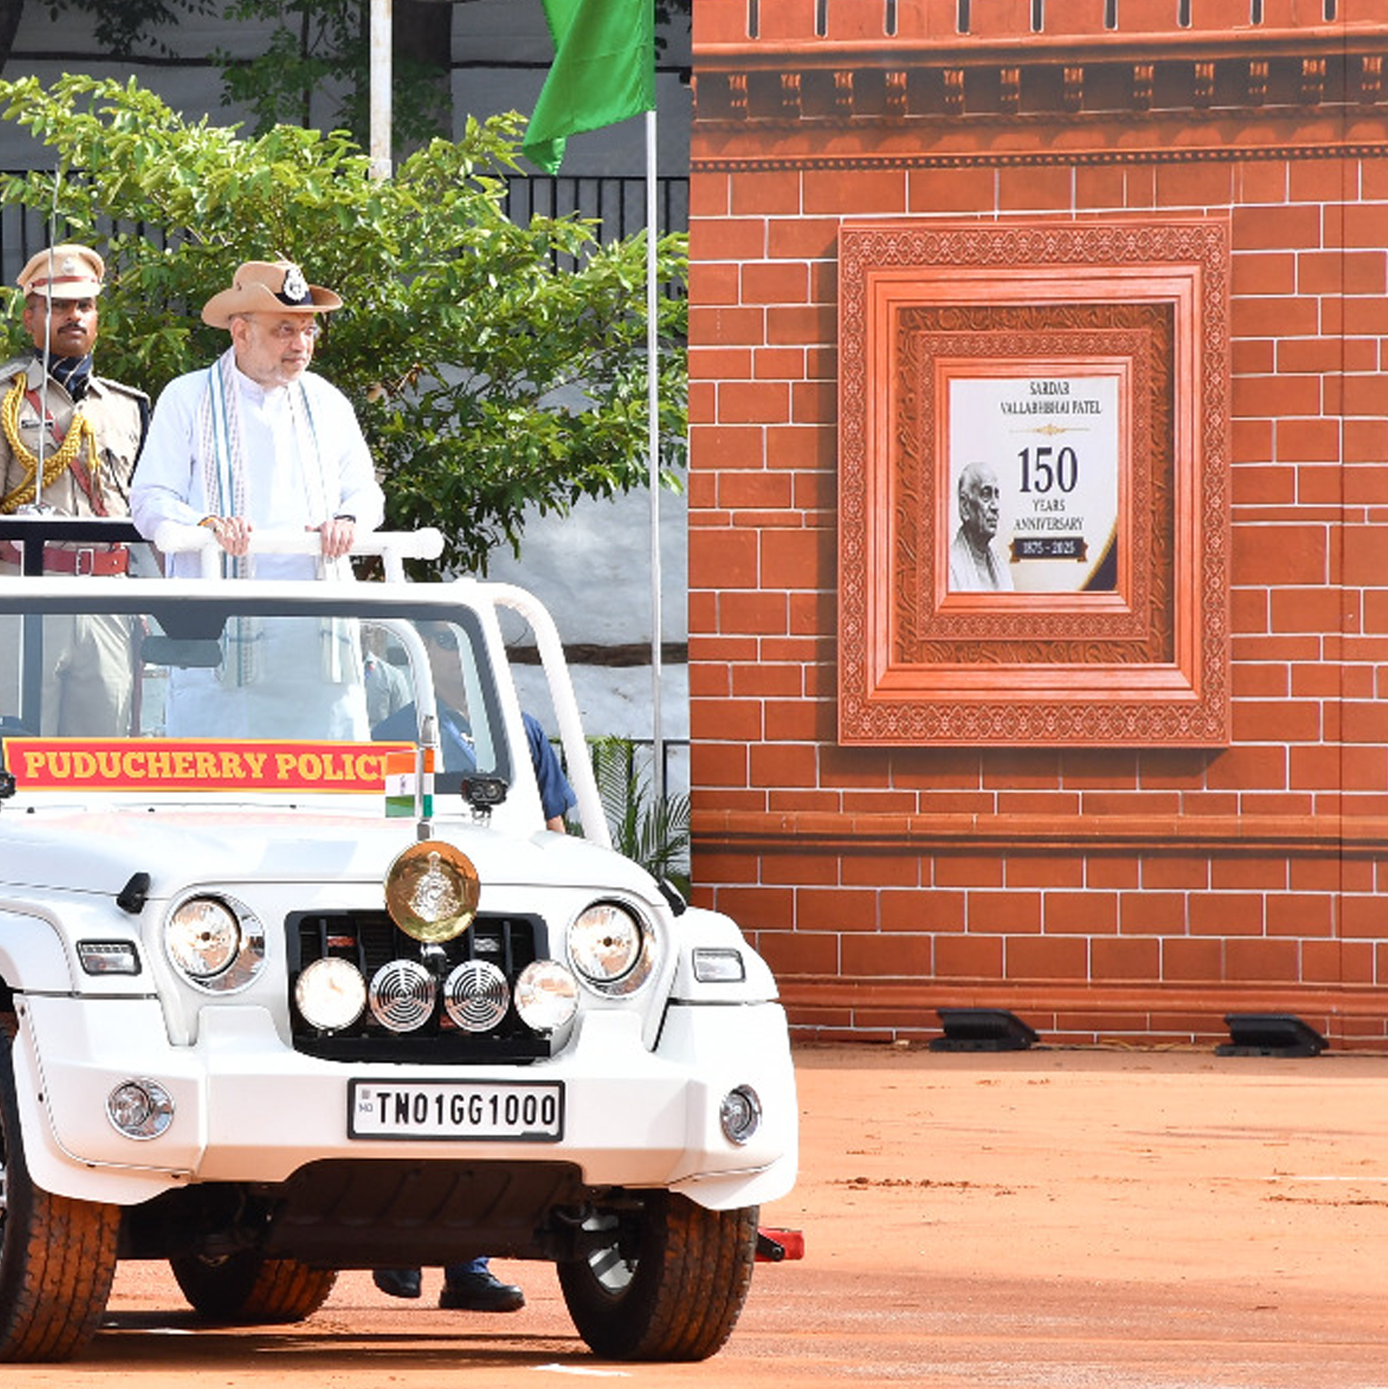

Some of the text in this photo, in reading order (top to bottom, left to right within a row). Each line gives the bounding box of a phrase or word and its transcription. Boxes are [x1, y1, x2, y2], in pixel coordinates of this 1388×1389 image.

[1029, 381, 1071, 396] SARDAR
[1072, 400, 1102, 415] PATEL
[1016, 446, 1078, 494] 150
[1032, 498, 1066, 513] YEARS
[1013, 516, 1085, 531] ANNIVERSARY
[22, 750, 268, 780] PUDUCHERRY
[376, 1092, 556, 1126] TN01GG1000
